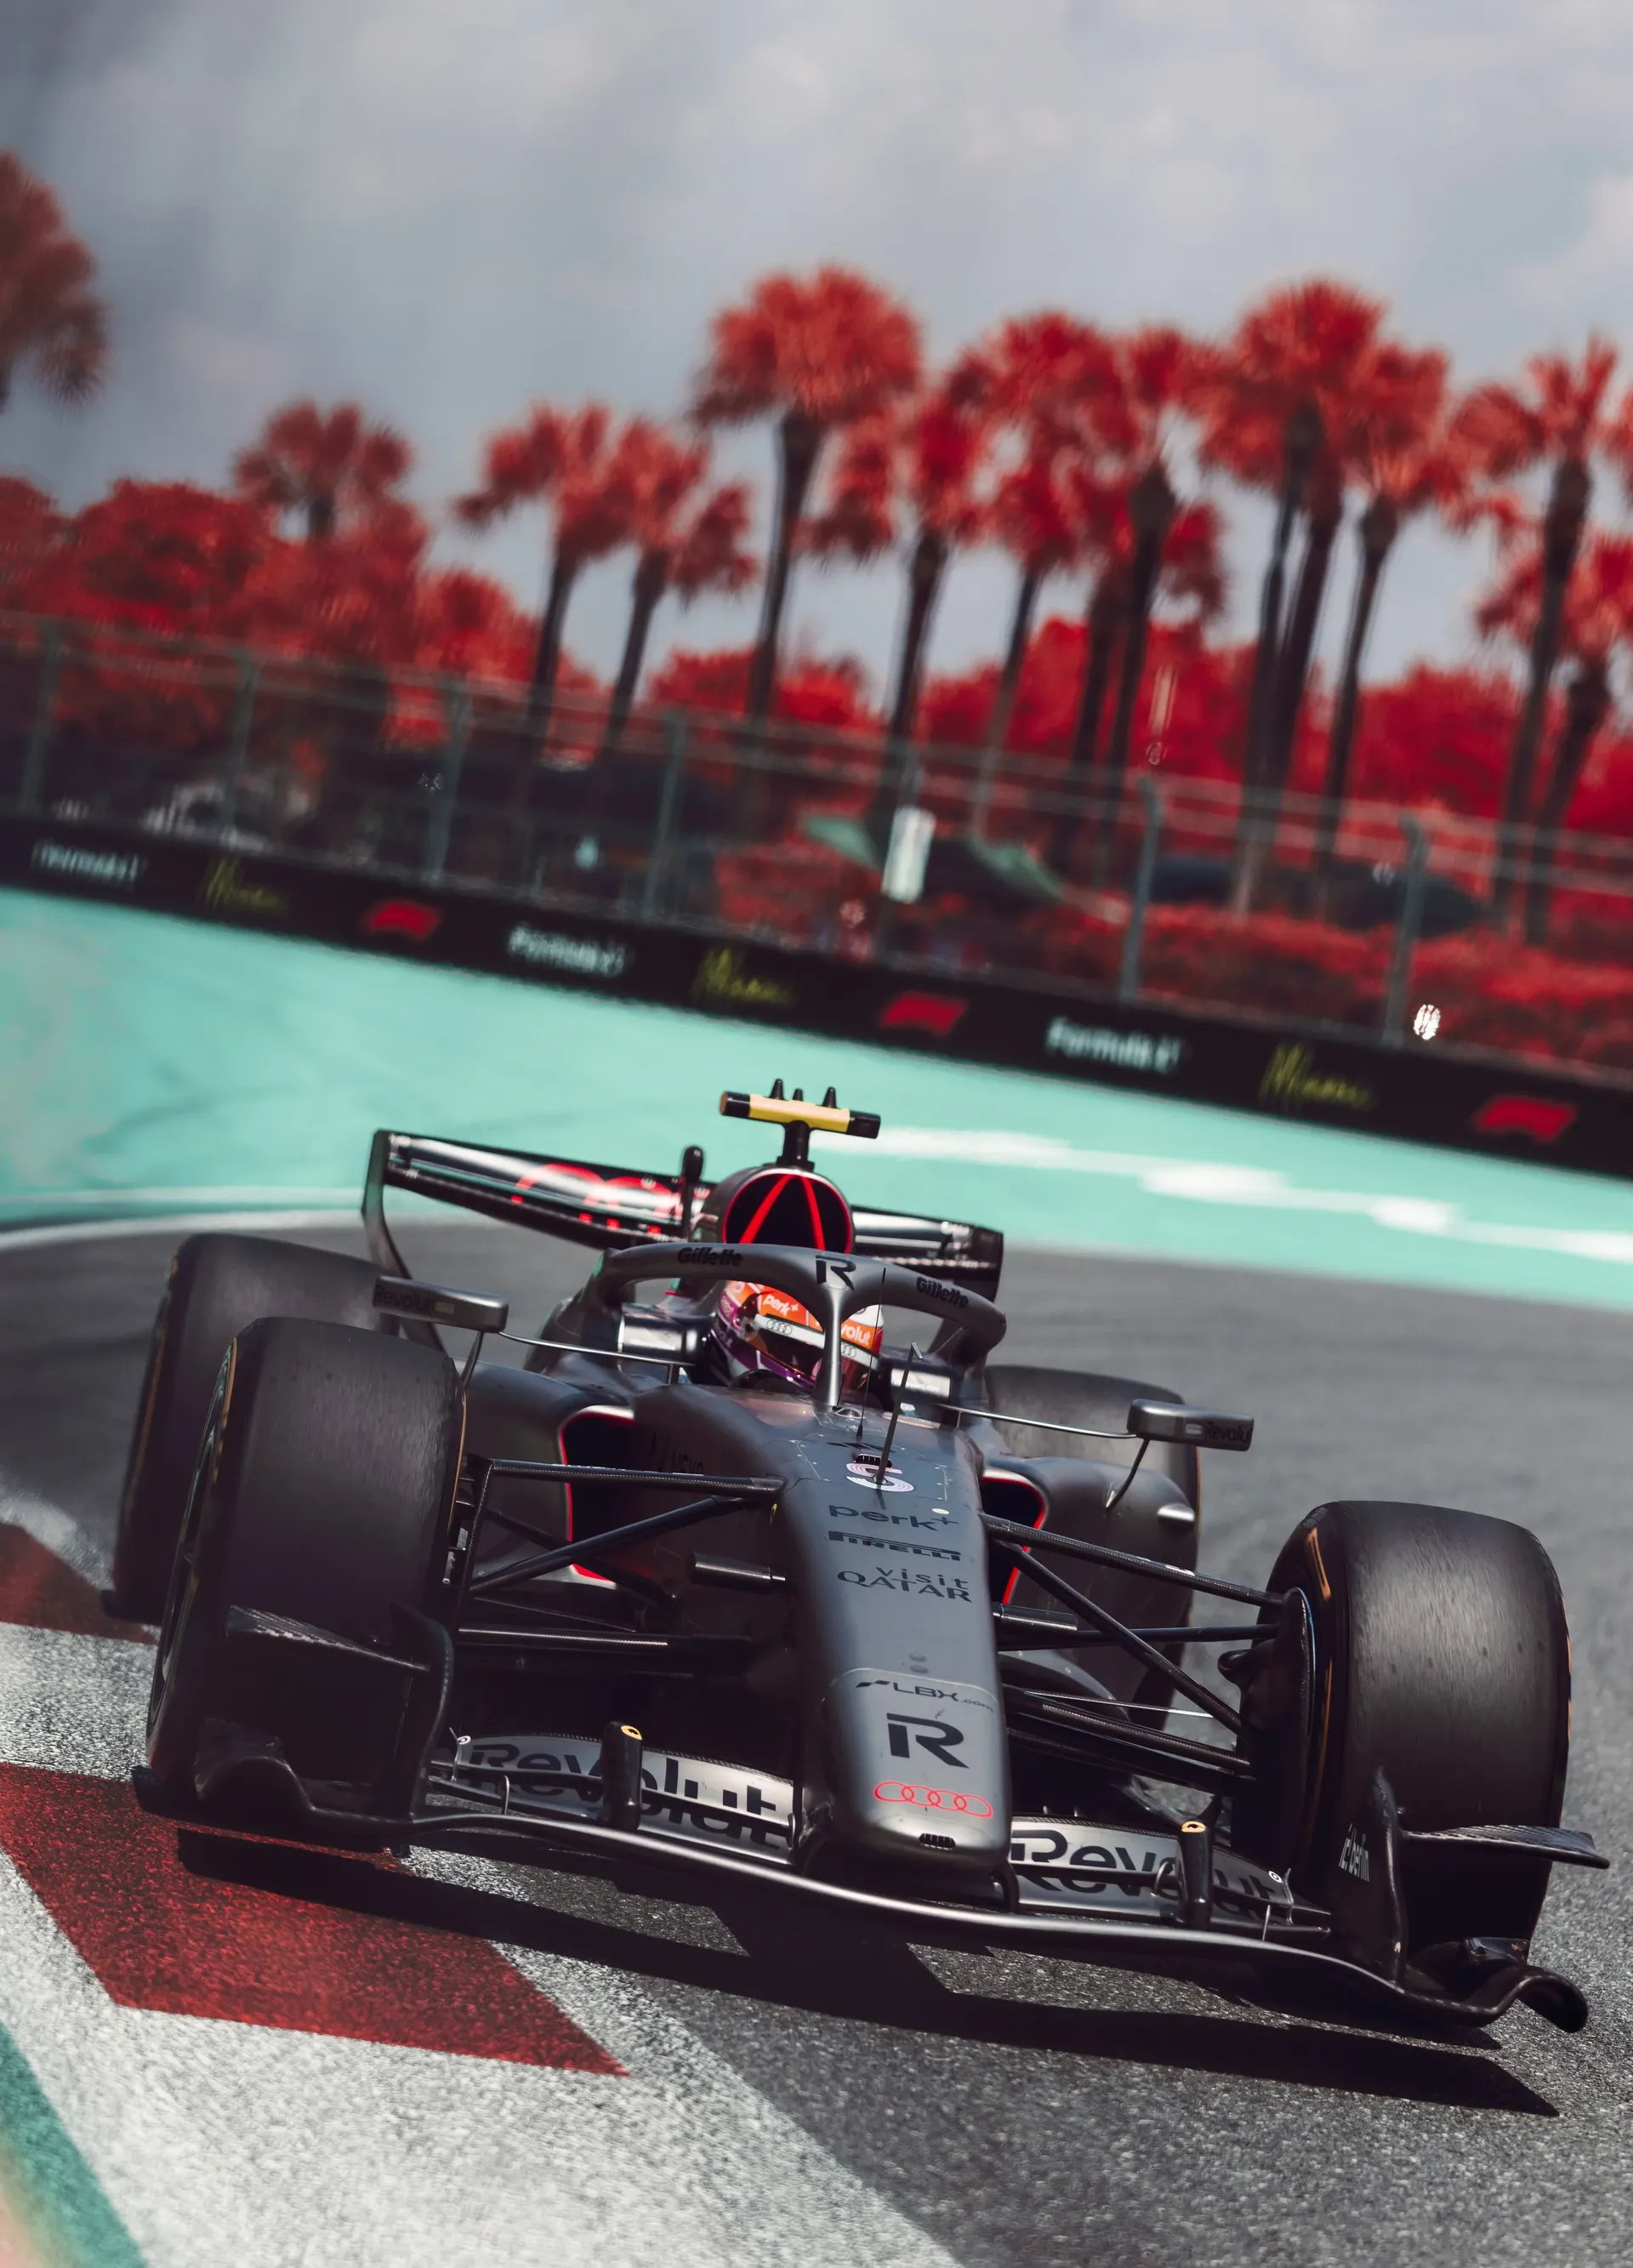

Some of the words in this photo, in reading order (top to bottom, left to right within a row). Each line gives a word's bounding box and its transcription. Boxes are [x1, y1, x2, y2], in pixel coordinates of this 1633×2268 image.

[677, 1246, 743, 1267] Gillette
[916, 1276, 970, 1309] Gillette
[828, 1530, 961, 1561] PIRELLI
[837, 1570, 973, 1603] QATAR
[886, 1712, 970, 1769] R
